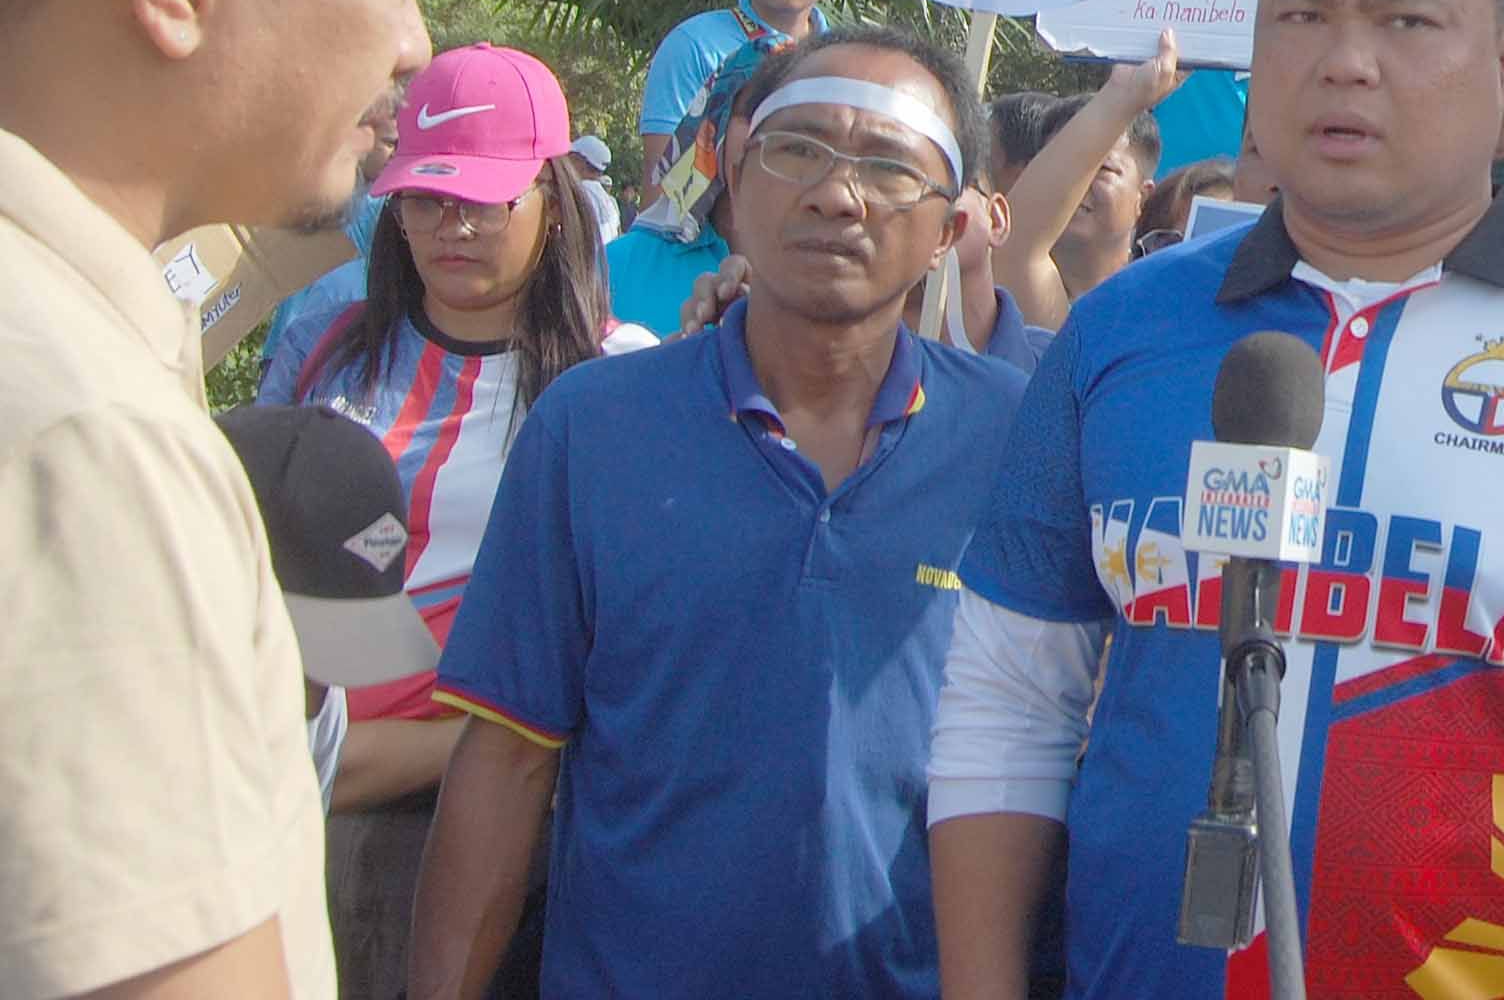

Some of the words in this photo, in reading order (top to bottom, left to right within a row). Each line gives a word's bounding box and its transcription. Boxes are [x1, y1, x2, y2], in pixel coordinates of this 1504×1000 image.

[1203, 467, 1270, 495] GMA
[1198, 505, 1268, 542] NEWS
[1289, 512, 1319, 548] NEWS
